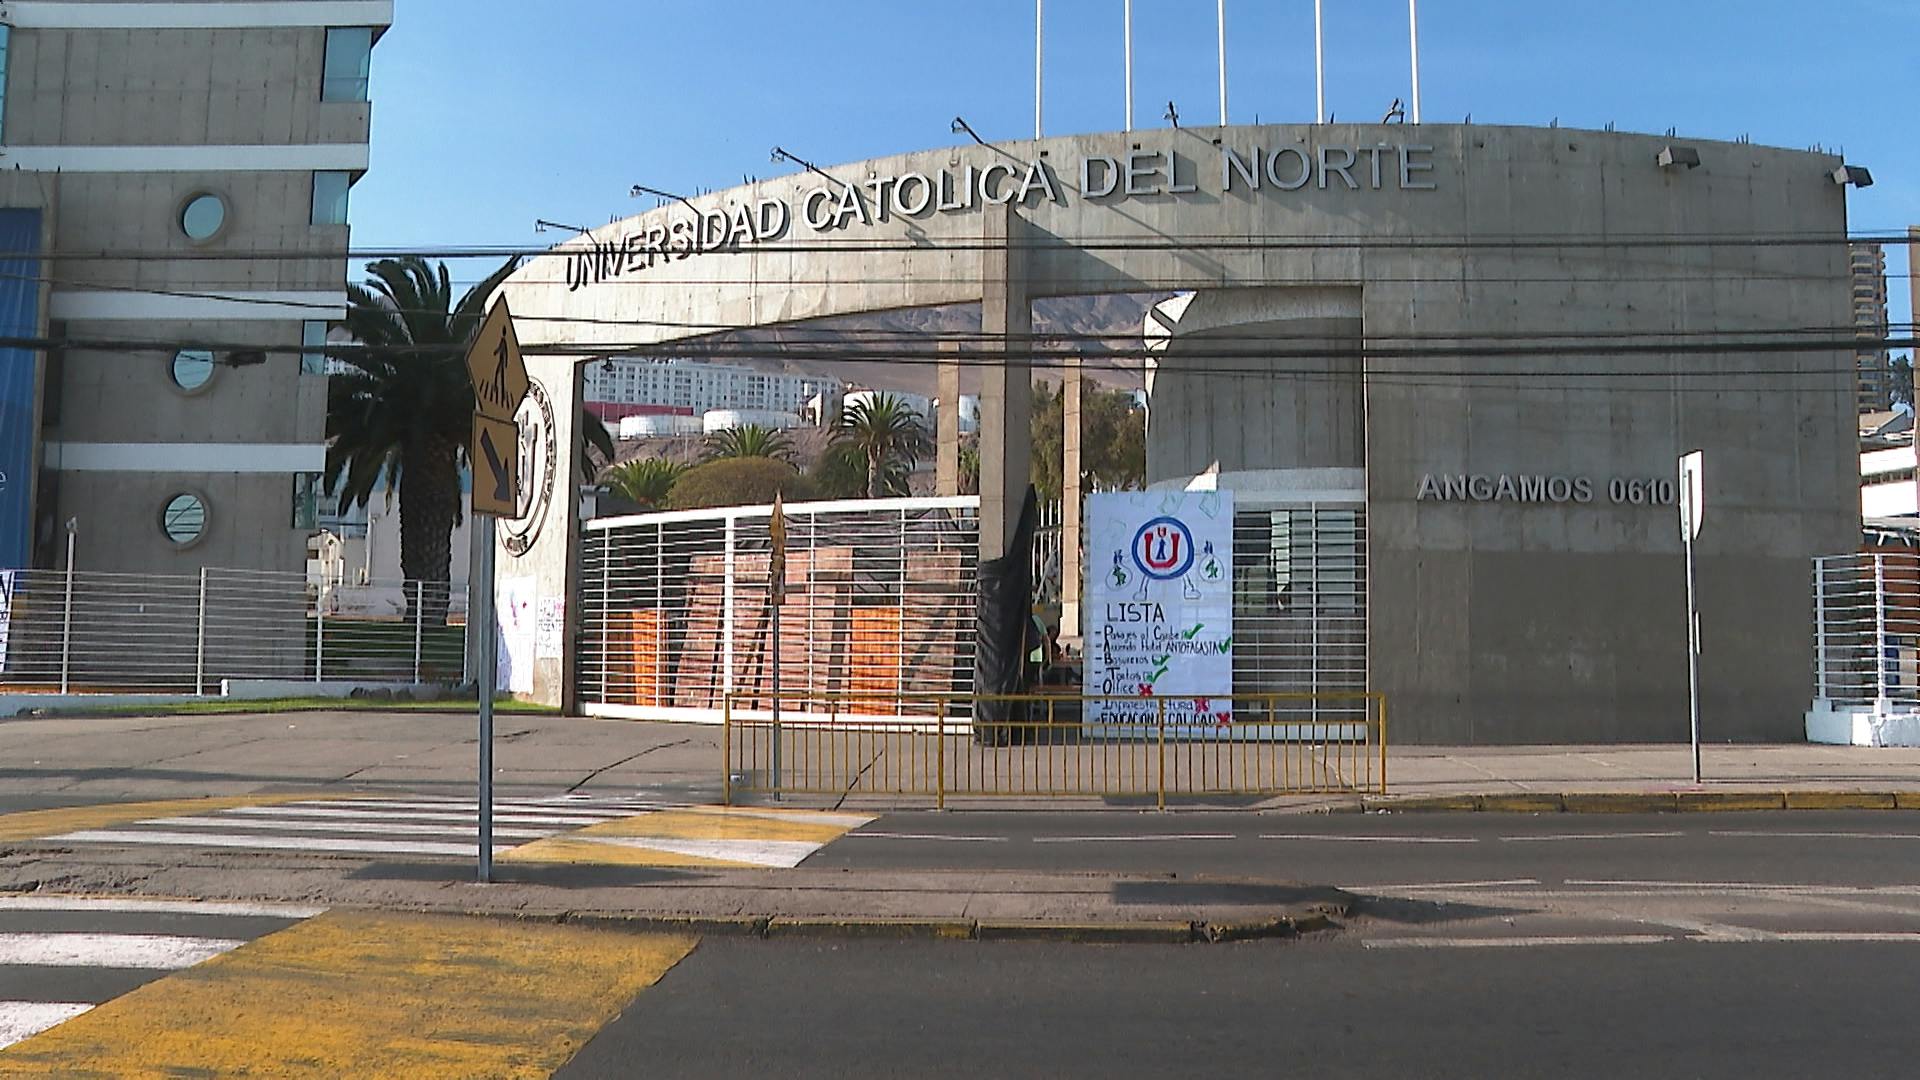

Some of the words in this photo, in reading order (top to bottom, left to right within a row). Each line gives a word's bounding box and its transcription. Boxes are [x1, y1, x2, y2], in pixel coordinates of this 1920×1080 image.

[565, 196, 789, 292] UNIVERSIDAD
[802, 158, 1060, 231] CATOLICA
[1080, 150, 1197, 200] DEL
[1222, 143, 1437, 192] NORTE
[1416, 473, 1593, 502] ANGAMOS
[1608, 478, 1676, 505] 0610
[1107, 602, 1165, 622] LISTA
